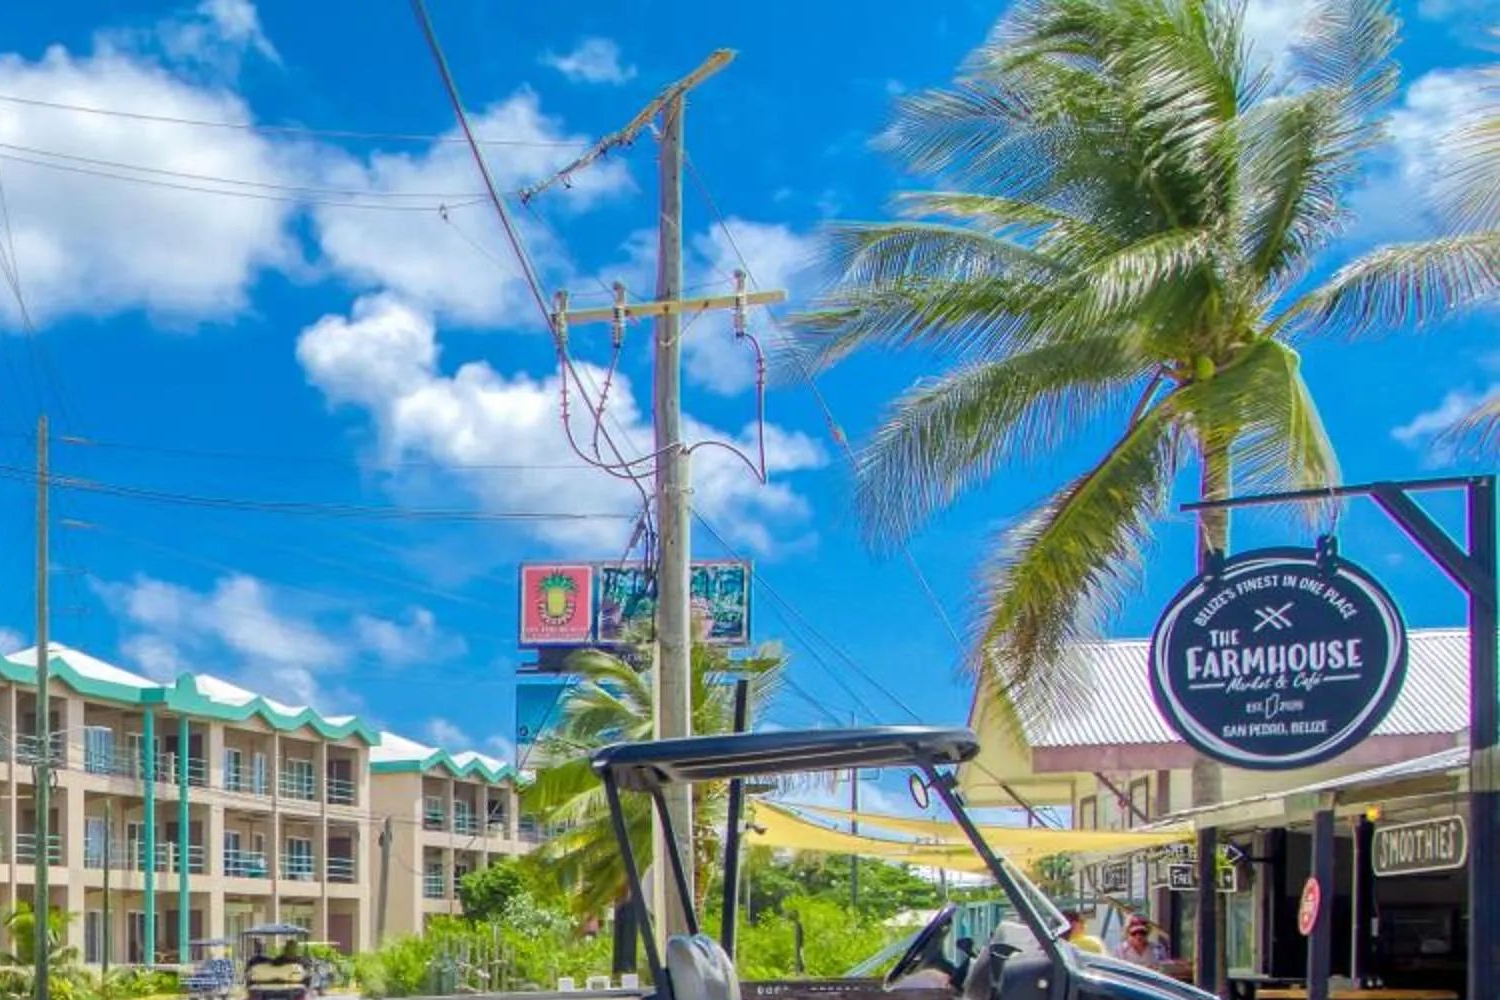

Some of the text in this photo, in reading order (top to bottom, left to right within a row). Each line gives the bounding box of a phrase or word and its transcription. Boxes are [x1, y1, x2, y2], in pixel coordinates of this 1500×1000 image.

[1193, 574, 1358, 627] BELIZE'S FINEST IN ONE PLACE
[1186, 638, 1363, 680] FARMHOUSE
[1209, 629, 1240, 648] THE
[1223, 725, 1246, 737] SAN
[1292, 720, 1327, 734] BELIZE
[1380, 821, 1457, 869] SMOOTHIES
